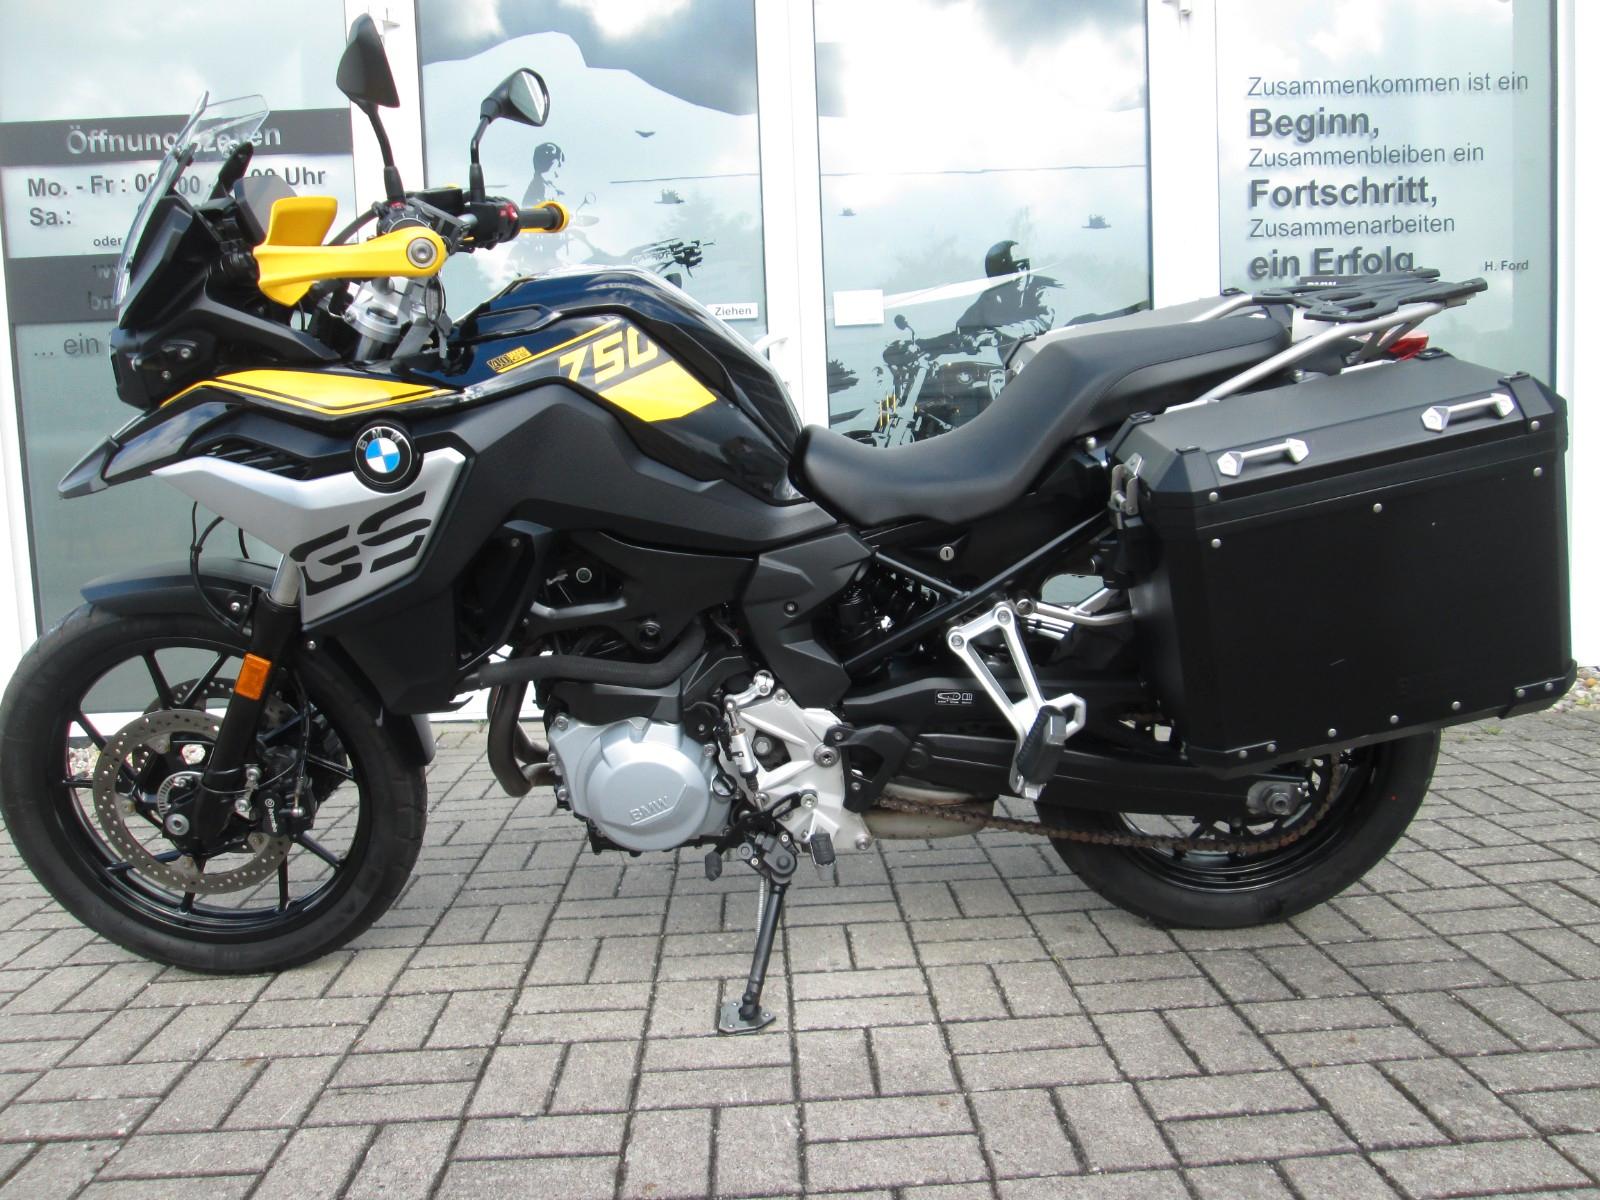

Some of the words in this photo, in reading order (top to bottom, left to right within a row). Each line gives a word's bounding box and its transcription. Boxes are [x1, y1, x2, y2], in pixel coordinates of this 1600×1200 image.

[1247, 74, 1460, 97] Zusammenkommen
[1467, 72, 1490, 91] ist
[1498, 71, 1529, 91] ein
[1249, 106, 1380, 144] Beginn,
[1248, 145, 1446, 168] Zusammenbleiben
[1453, 142, 1485, 162] ein
[27, 177, 68, 198] Mo.
[285, 166, 326, 186] Uhr
[1250, 175, 1438, 208] Fortschritt,
[29, 206, 72, 227] Sa.:
[1249, 214, 1455, 238] Zusammenarbeiten
[93, 235, 123, 248] oder
[1249, 248, 1301, 278] ein
[1484, 260, 1496, 272] H.
[1500, 259, 1529, 272] Ford
[715, 306, 752, 317] Ziehen
[63, 332, 100, 356] ein
[559, 326, 659, 385] 750
[357, 427, 404, 451] BMW
[289, 490, 432, 597] GS
[630, 796, 668, 821] BMW
